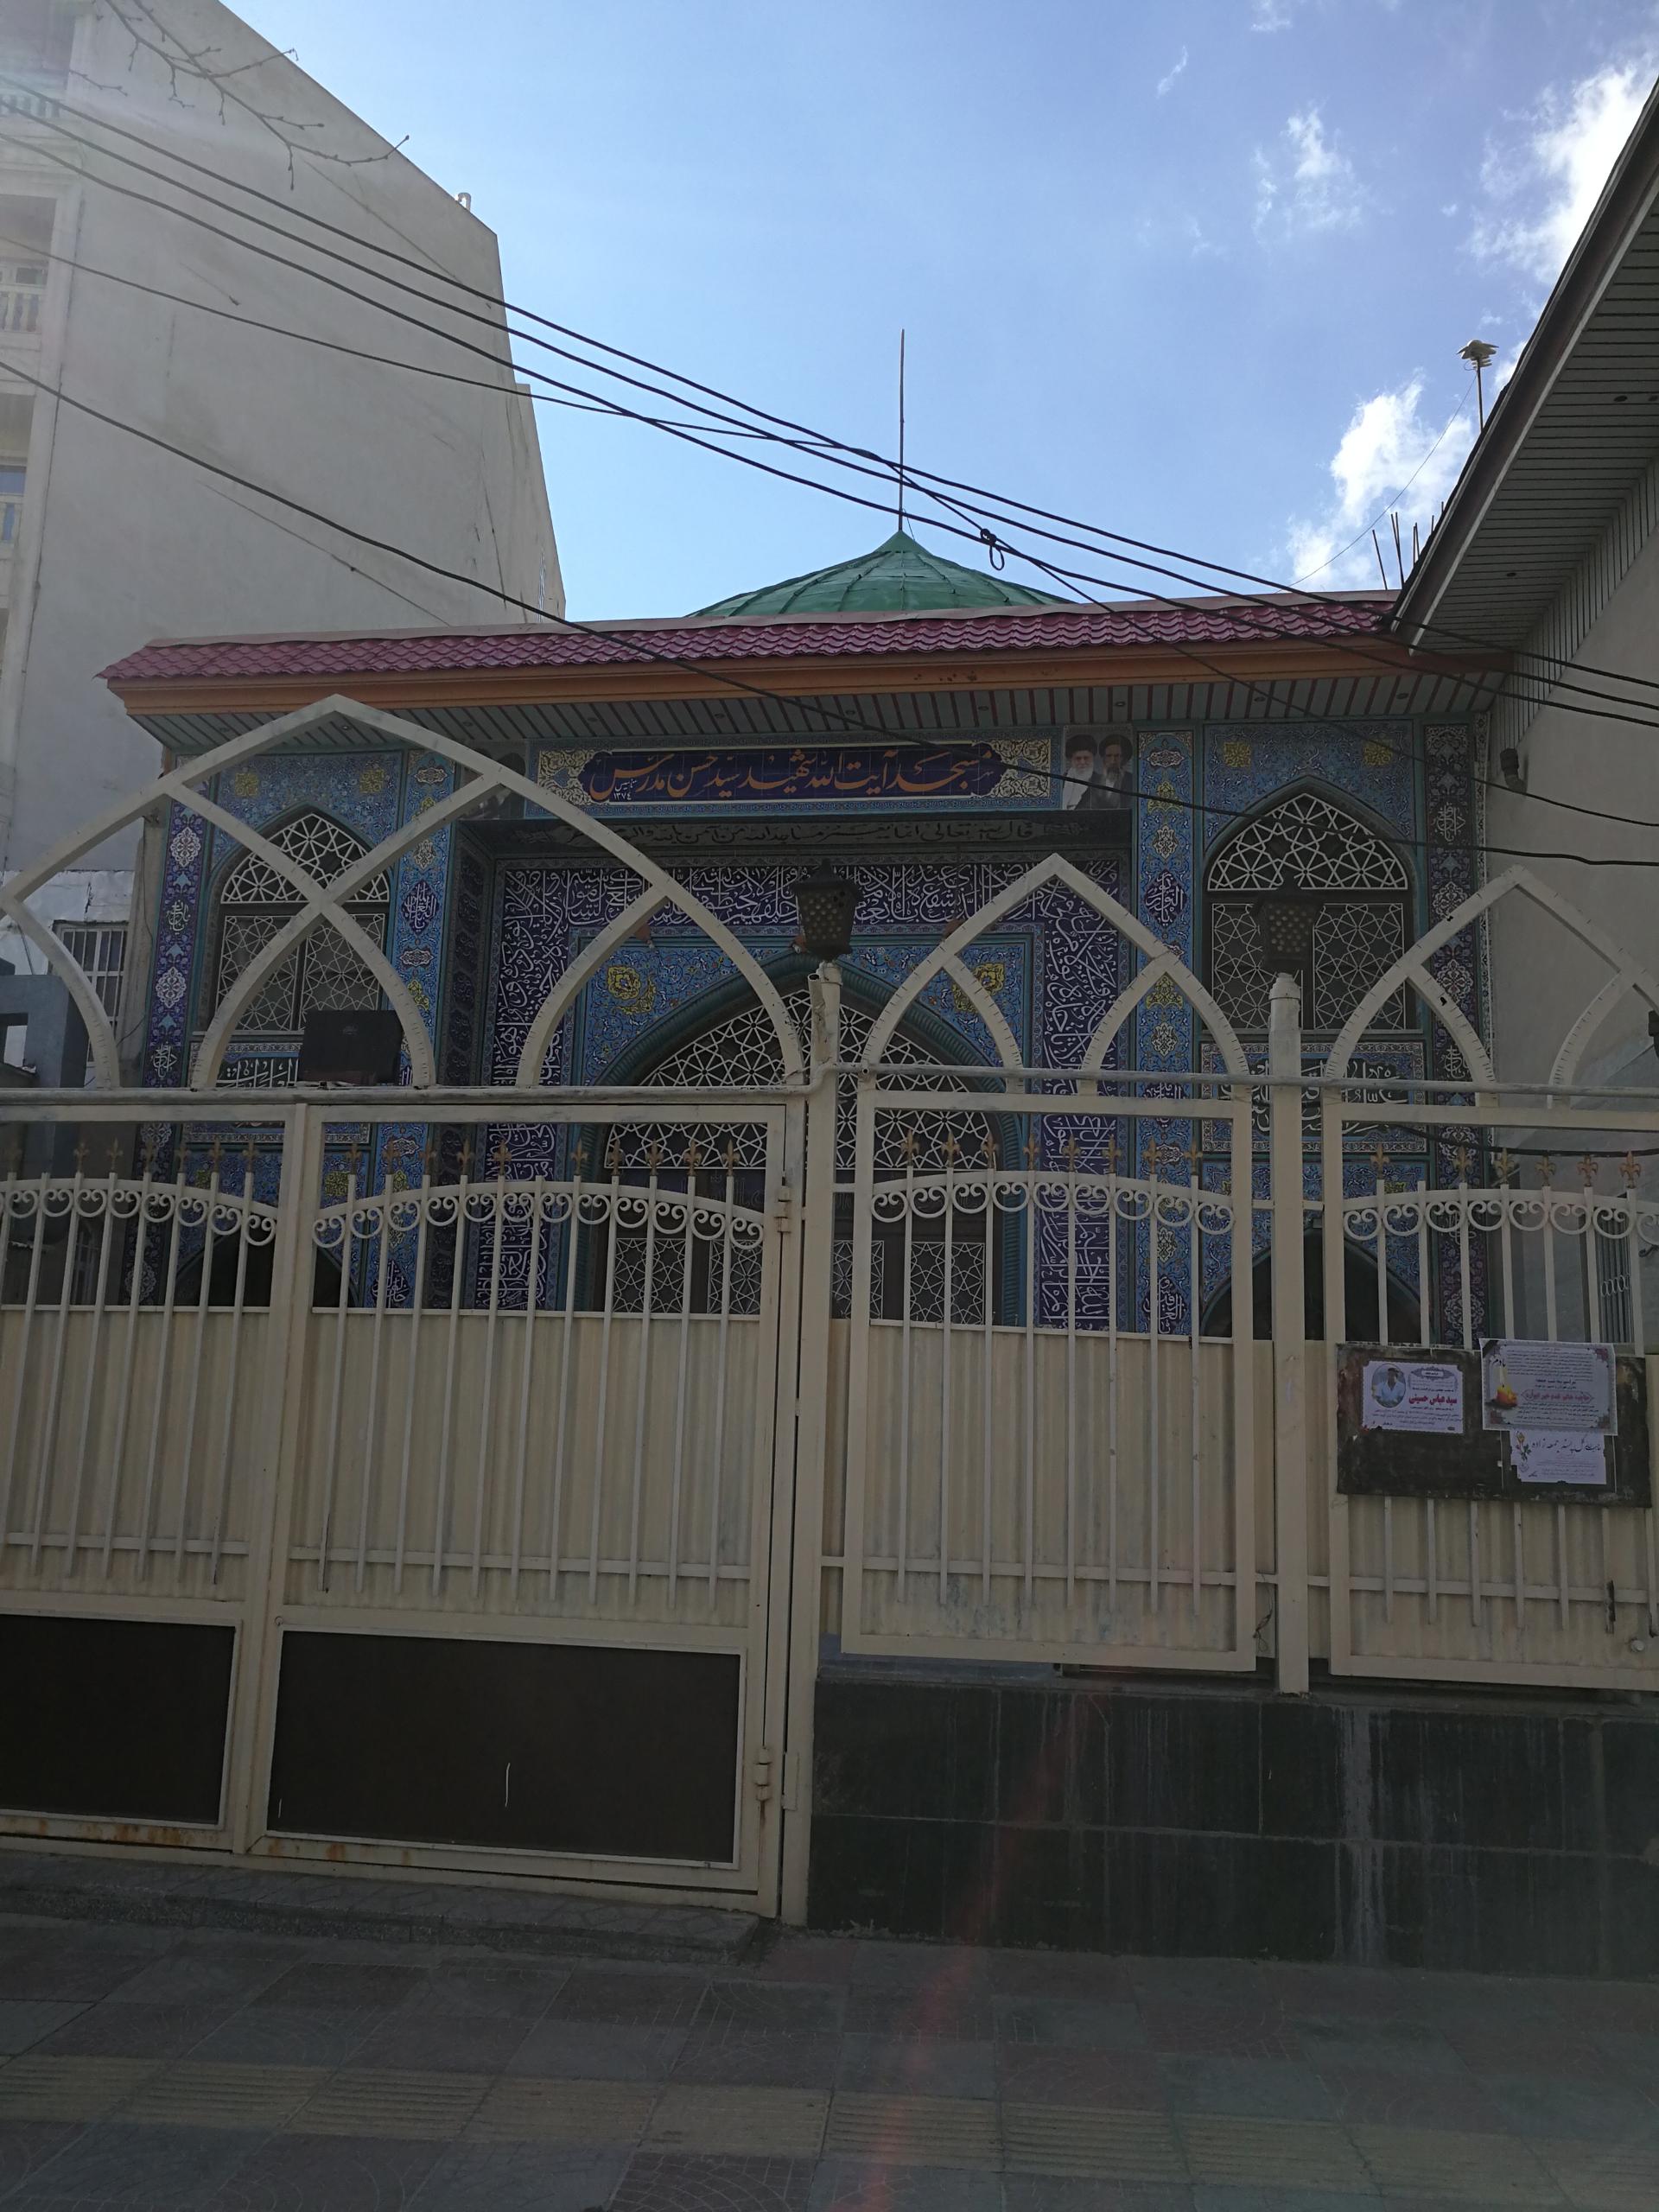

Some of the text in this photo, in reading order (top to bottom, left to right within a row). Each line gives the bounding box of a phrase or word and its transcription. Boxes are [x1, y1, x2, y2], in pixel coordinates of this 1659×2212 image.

[589, 753, 675, 801] مدرس
[666, 753, 719, 798] حسن
[702, 755, 741, 798] سید
[737, 748, 817, 794] شهید
[804, 750, 843, 789] الله
[886, 749, 993, 792] مسجد
